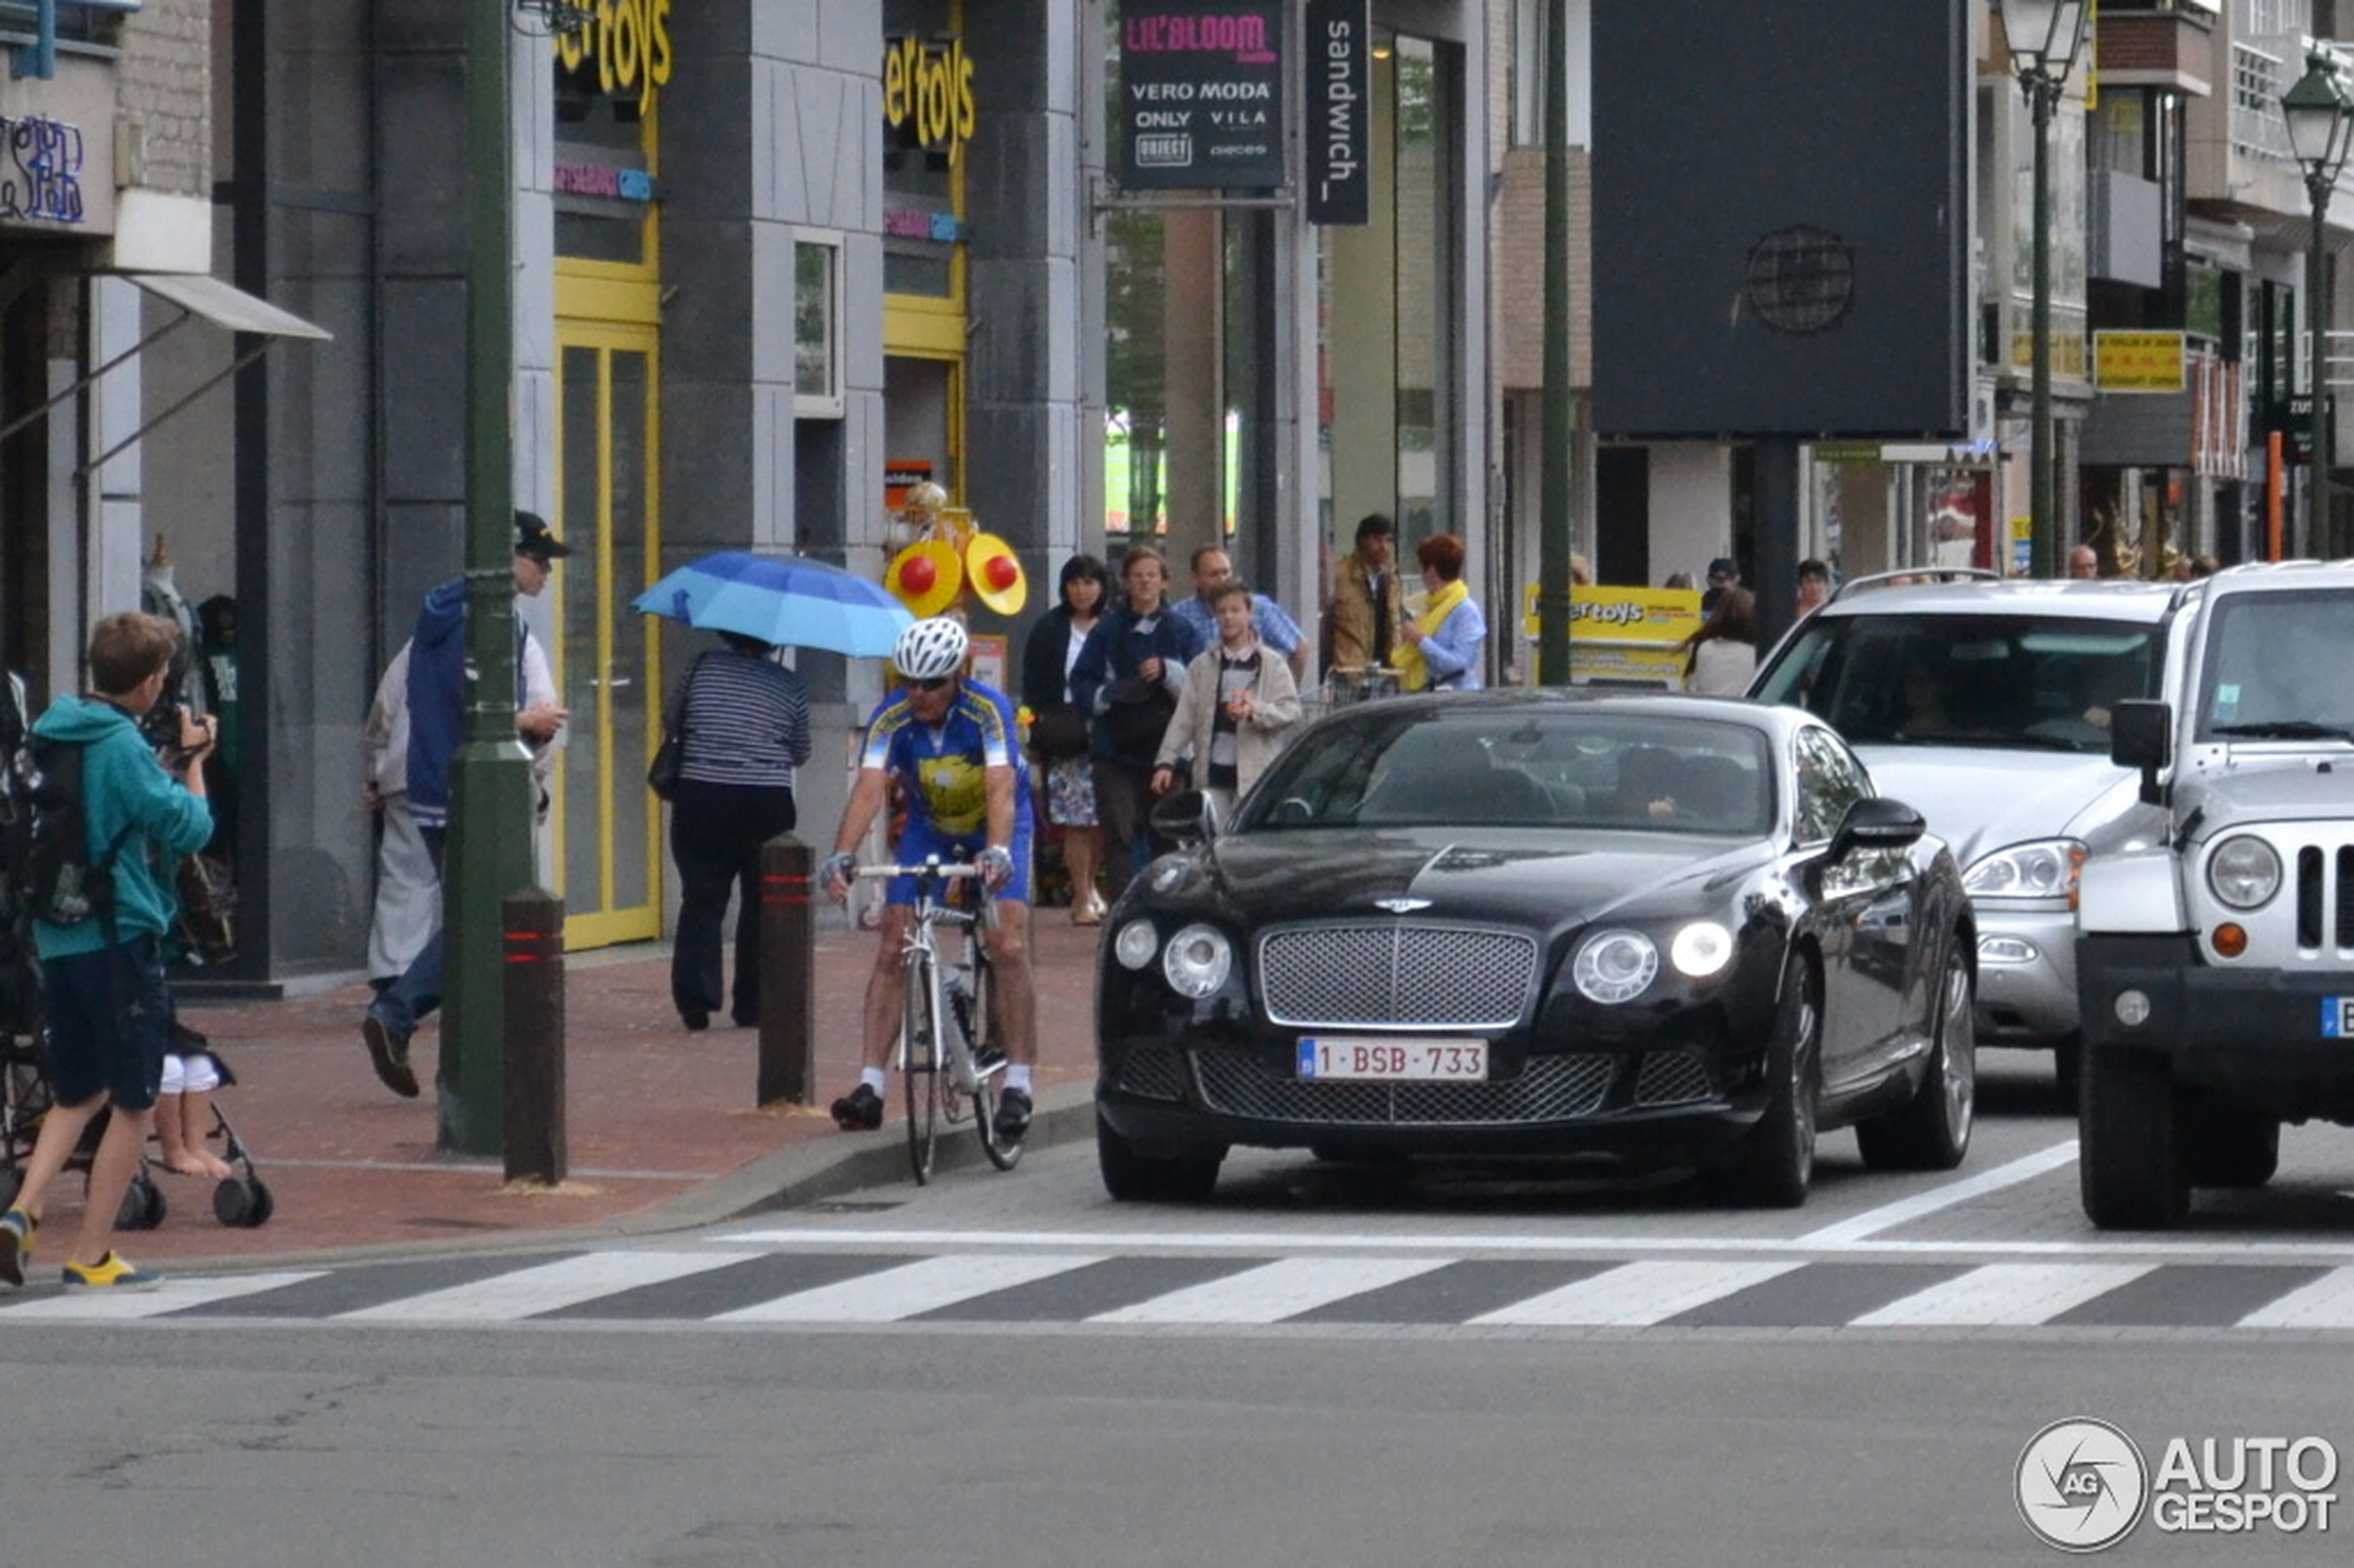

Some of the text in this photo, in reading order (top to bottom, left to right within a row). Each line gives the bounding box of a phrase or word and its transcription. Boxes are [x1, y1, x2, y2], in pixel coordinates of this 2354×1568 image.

[1132, 81, 1271, 101] VERO MODA
[1135, 110, 1267, 128] ONLY VILA
[1321, 1046, 1482, 1074] 1-BSB-733
